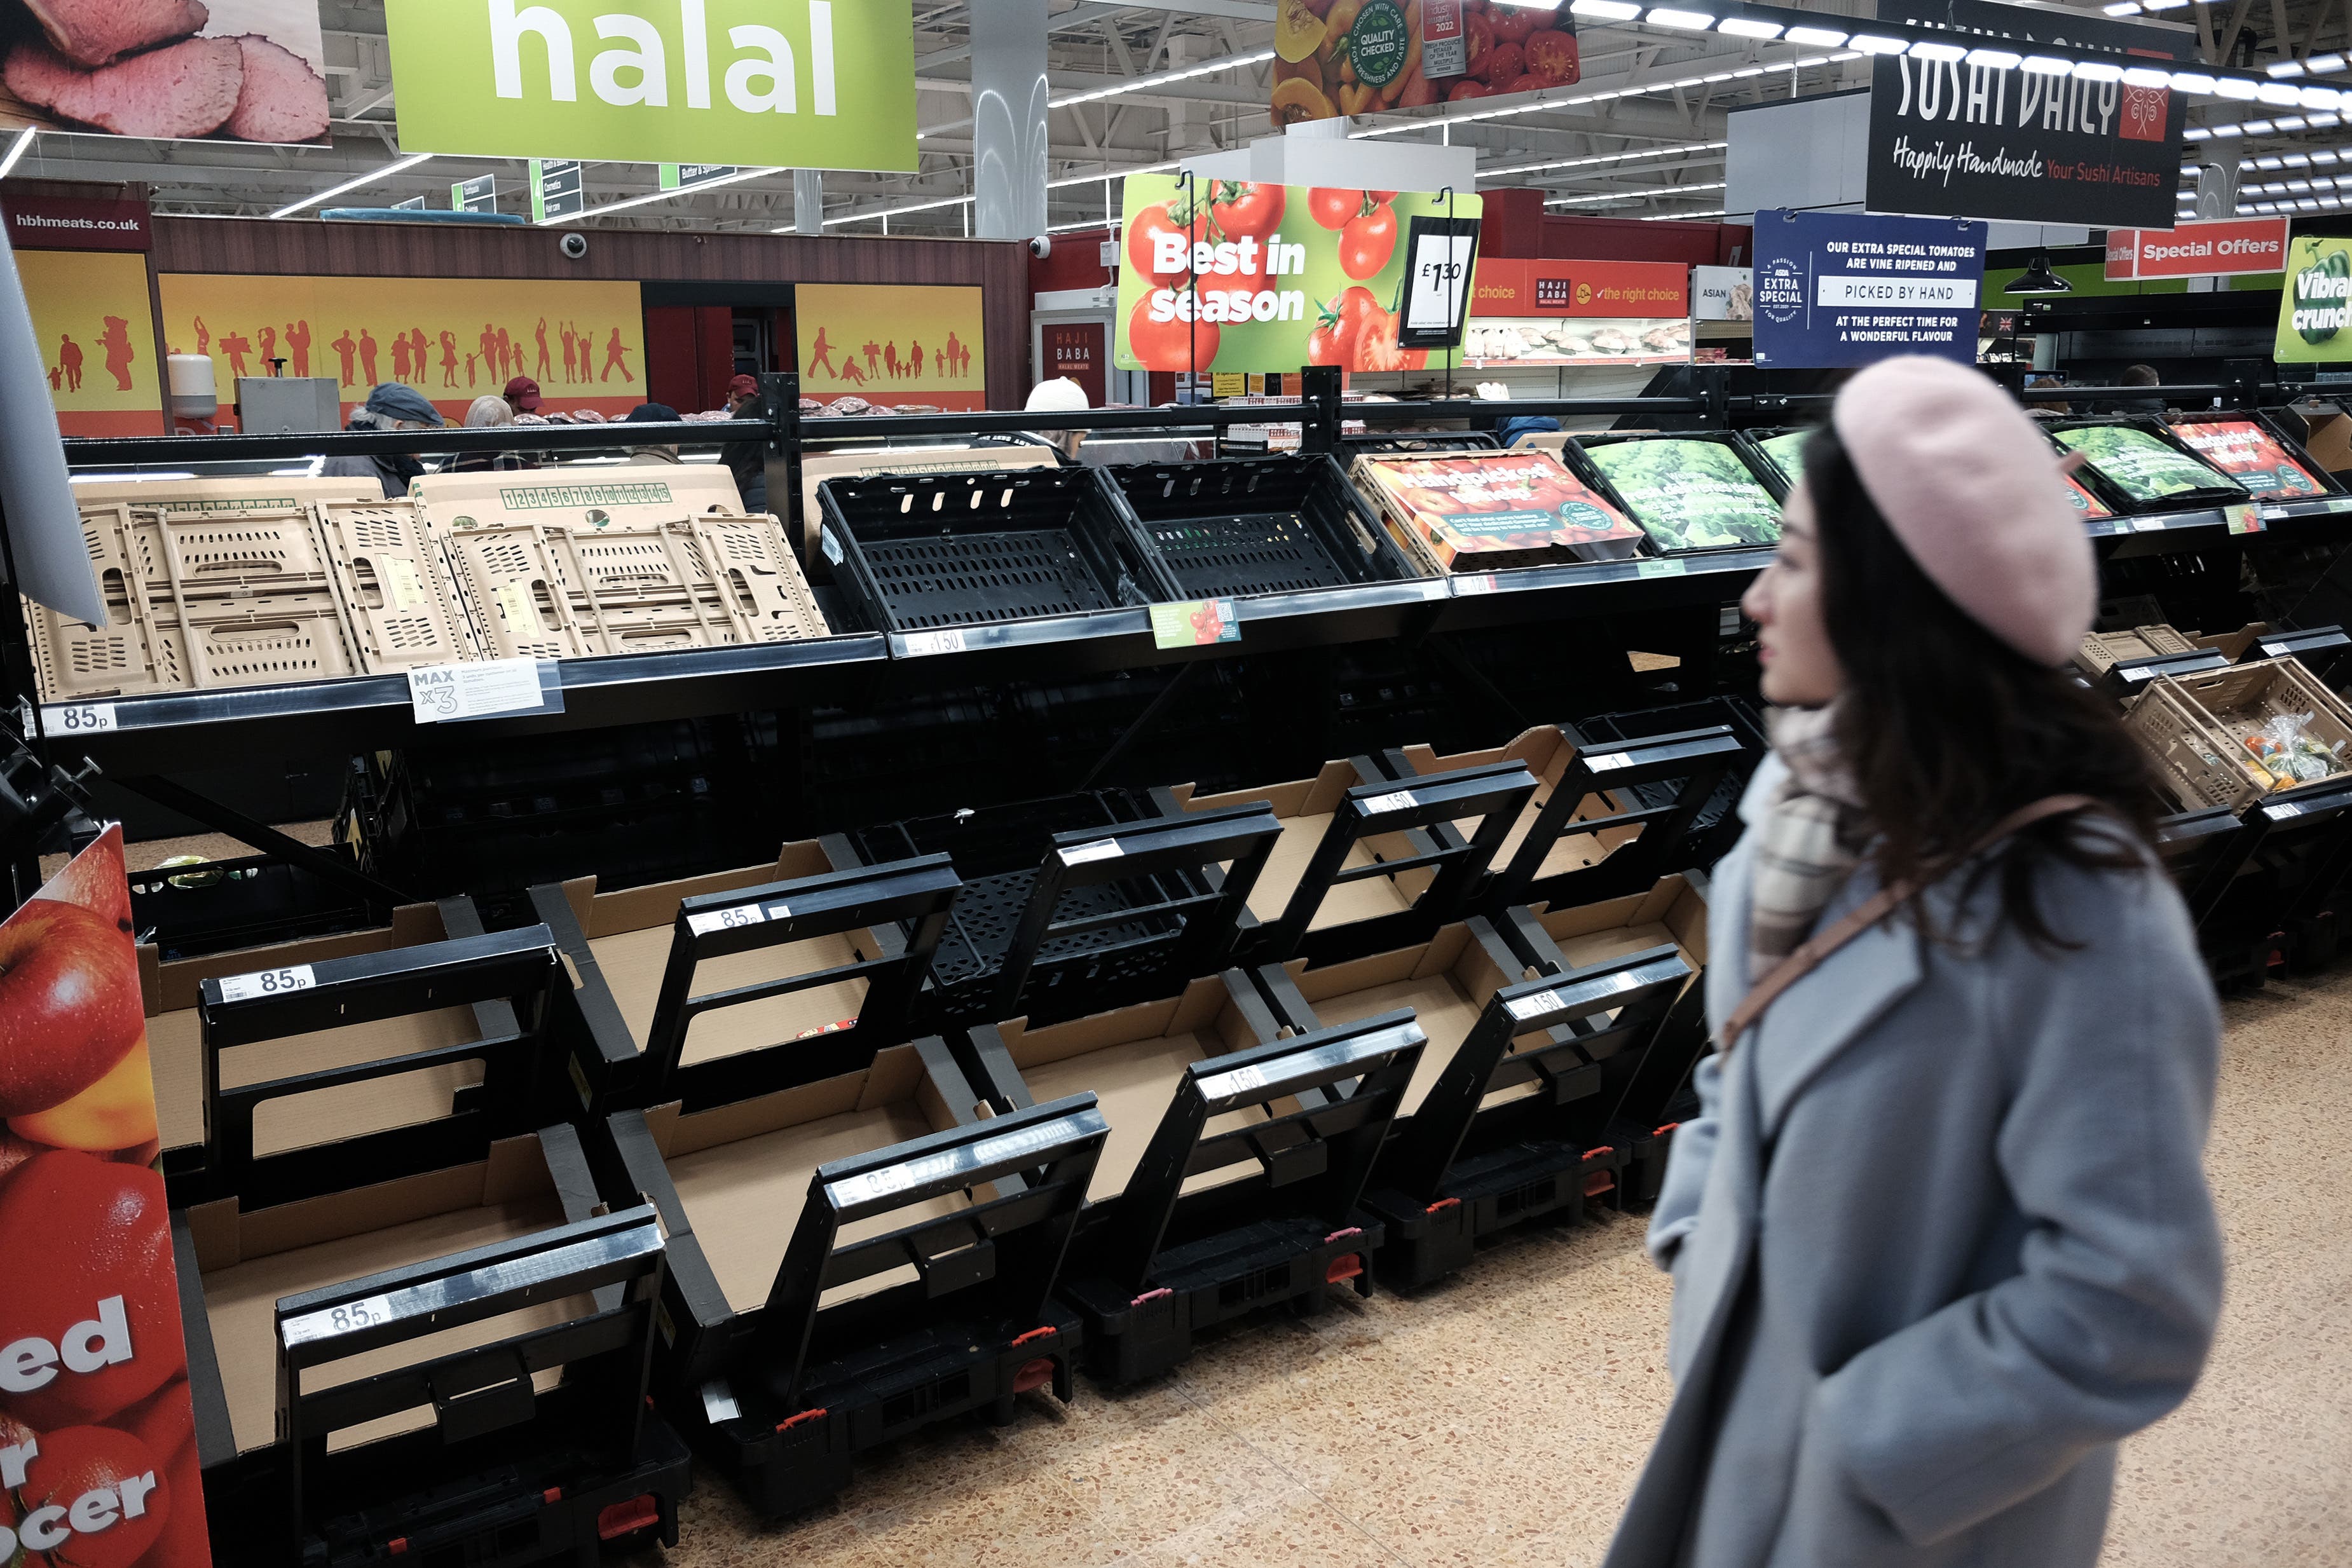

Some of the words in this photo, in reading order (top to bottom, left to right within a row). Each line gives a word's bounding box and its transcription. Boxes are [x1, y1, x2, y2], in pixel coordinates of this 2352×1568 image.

[1353, 6, 1373, 36] CHOSEN
[1375, 3, 1389, 11] WITH
[1390, 9, 1403, 29] CARE
[1427, 13, 1453, 24] awards
[1436, 22, 1454, 32] 2022
[1361, 30, 1395, 45] QUALITY
[1439, 39, 1460, 48] PRODUCE
[1361, 43, 1395, 57] CHECKED
[488, 0, 837, 116] halal
[1356, 64, 1386, 83] FRESHNESS
[1387, 62, 1398, 79] AND
[1397, 37, 1405, 61] TASTE
[1893, 135, 1955, 187] Happily
[1957, 141, 2042, 177] Handmade
[681, 167, 697, 179] Butter
[2047, 159, 2074, 179] Your
[2076, 161, 2110, 182] Sushi
[2112, 166, 2160, 187] Artisans
[535, 179, 541, 200] 4
[16, 215, 139, 230] hbhmeats.co.uk
[1153, 233, 1258, 275] Best
[1266, 234, 1305, 275] in
[1827, 242, 1849, 253] OUR
[1852, 243, 1884, 254] EXTRA
[1887, 244, 1927, 256] SPECIAL
[1929, 245, 1975, 257] TOMATOES
[2143, 242, 2212, 261] Special
[2217, 239, 2279, 255] Offers
[1772, 258, 1797, 270] PASSION
[1846, 257, 1866, 269] ARE
[1870, 259, 1892, 269] VINE
[1895, 259, 1935, 271] RIPENED
[1937, 261, 1957, 271] AND
[1764, 278, 1798, 290] EXTRA
[1479, 285, 1515, 299] choice
[1604, 287, 1620, 299] the
[1622, 288, 1645, 303] right
[1648, 289, 1679, 301] choice
[1702, 289, 1726, 297] ASIAN
[1760, 291, 1802, 303] SPECIAL
[1845, 285, 1893, 299] PICKED
[1899, 286, 1915, 299] BY
[1920, 287, 1953, 299] HAND
[1151, 290, 1304, 322] season
[1765, 310, 1774, 320] FOR
[1775, 310, 1796, 323] QUALITY
[1836, 316, 1849, 327] AT
[1851, 317, 1870, 326] THE
[1873, 317, 1915, 327] PERFECT
[1917, 317, 1938, 327] TIME
[1939, 317, 1958, 327] FOR
[1056, 332, 1088, 344] HAJI
[1840, 331, 1848, 341] A
[1850, 331, 1910, 341] WONDERFUL
[1912, 331, 1953, 341] FLAVOUR
[1057, 348, 1090, 360] BABA
[1398, 462, 1555, 489] Handpicked
[506, 494, 512, 505] 1
[517, 493, 525, 505] 2
[528, 493, 536, 504] 3
[540, 493, 548, 503] 4
[552, 492, 559, 503] 5
[563, 492, 570, 502] 6
[573, 491, 580, 501] 7
[584, 491, 592, 501] 8
[596, 490, 603, 501] 9
[605, 490, 615, 500] 10
[615, 489, 626, 500] 11
[626, 489, 636, 500] 12
[637, 489, 647, 500] 13
[648, 488, 658, 499] 14
[659, 487, 668, 498] 15
[414, 670, 455, 686] MAX
[419, 685, 458, 714] x3
[63, 706, 107, 729] 85p
[721, 909, 757, 927] 85p
[260, 969, 306, 992] 85p
[331, 1302, 381, 1332] 85p
[0, 1295, 133, 1393] ed
